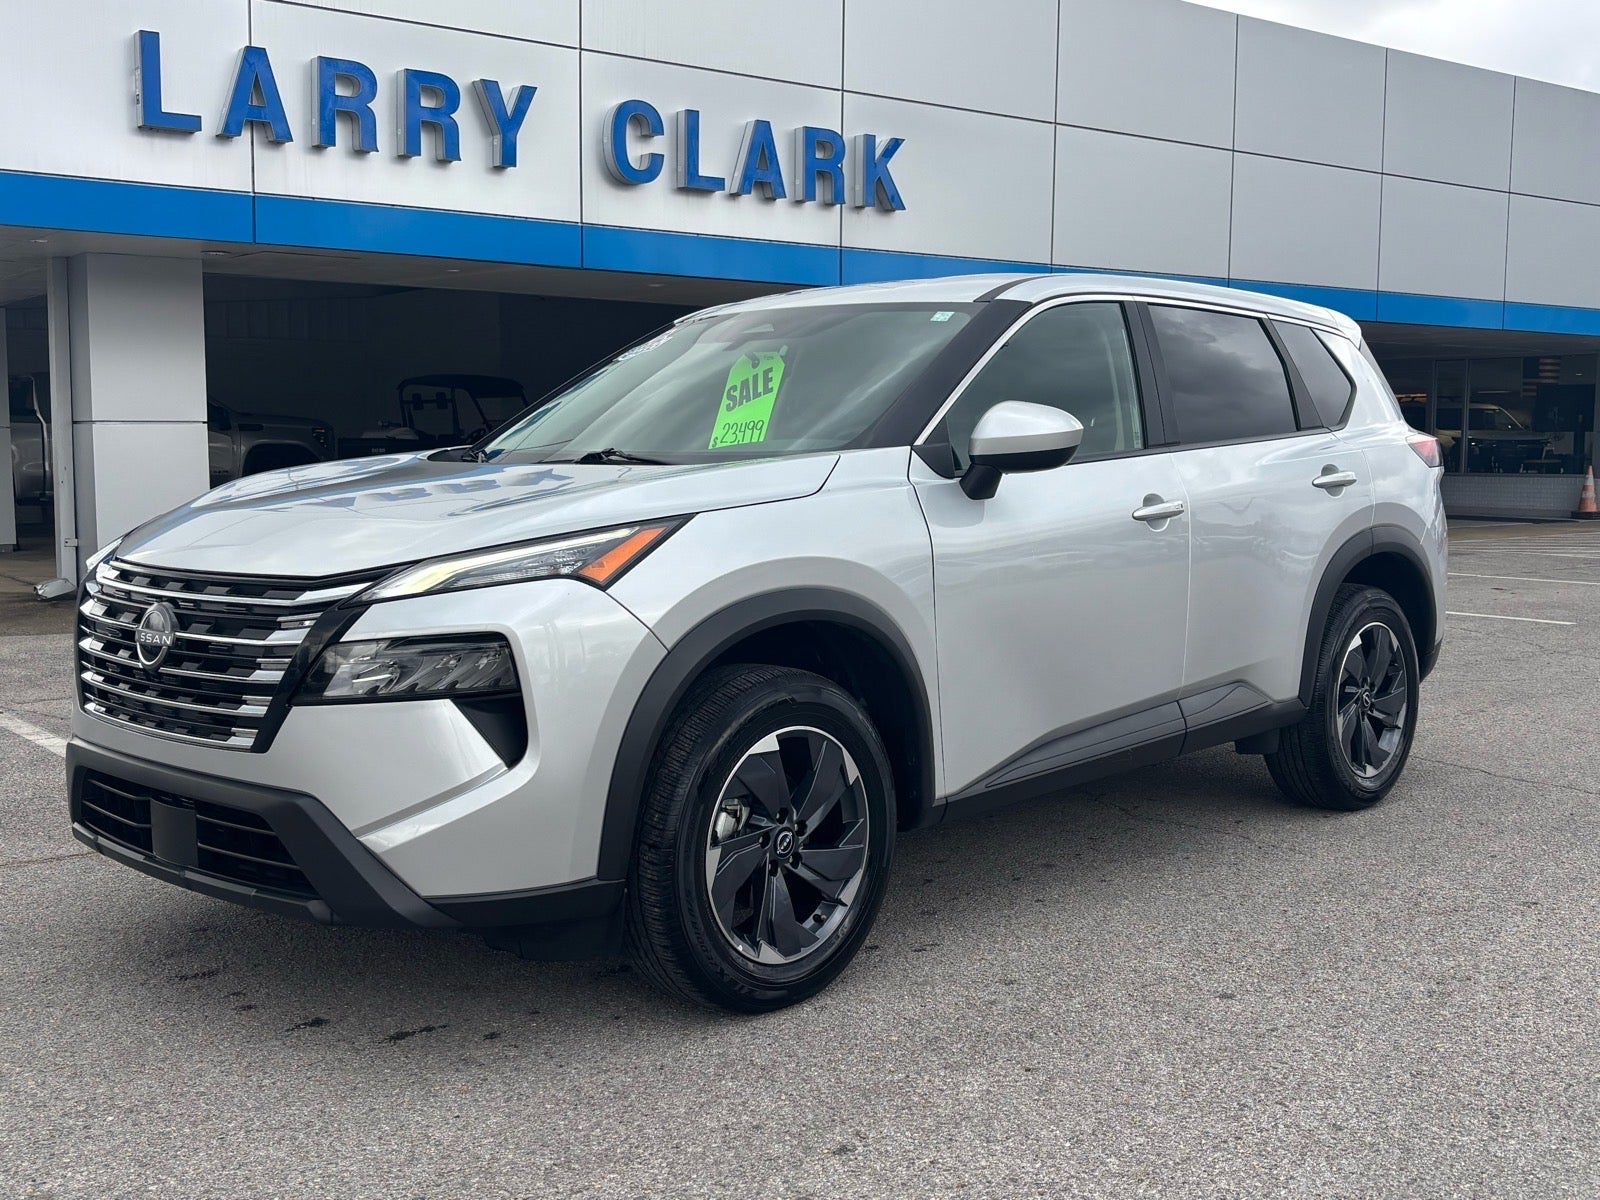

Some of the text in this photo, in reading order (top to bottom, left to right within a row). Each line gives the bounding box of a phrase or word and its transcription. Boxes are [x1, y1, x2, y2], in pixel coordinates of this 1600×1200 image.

[134, 30, 906, 211] LARRY CLARK
[726, 366, 774, 412] SALE
[140, 632, 172, 645] SSAN
